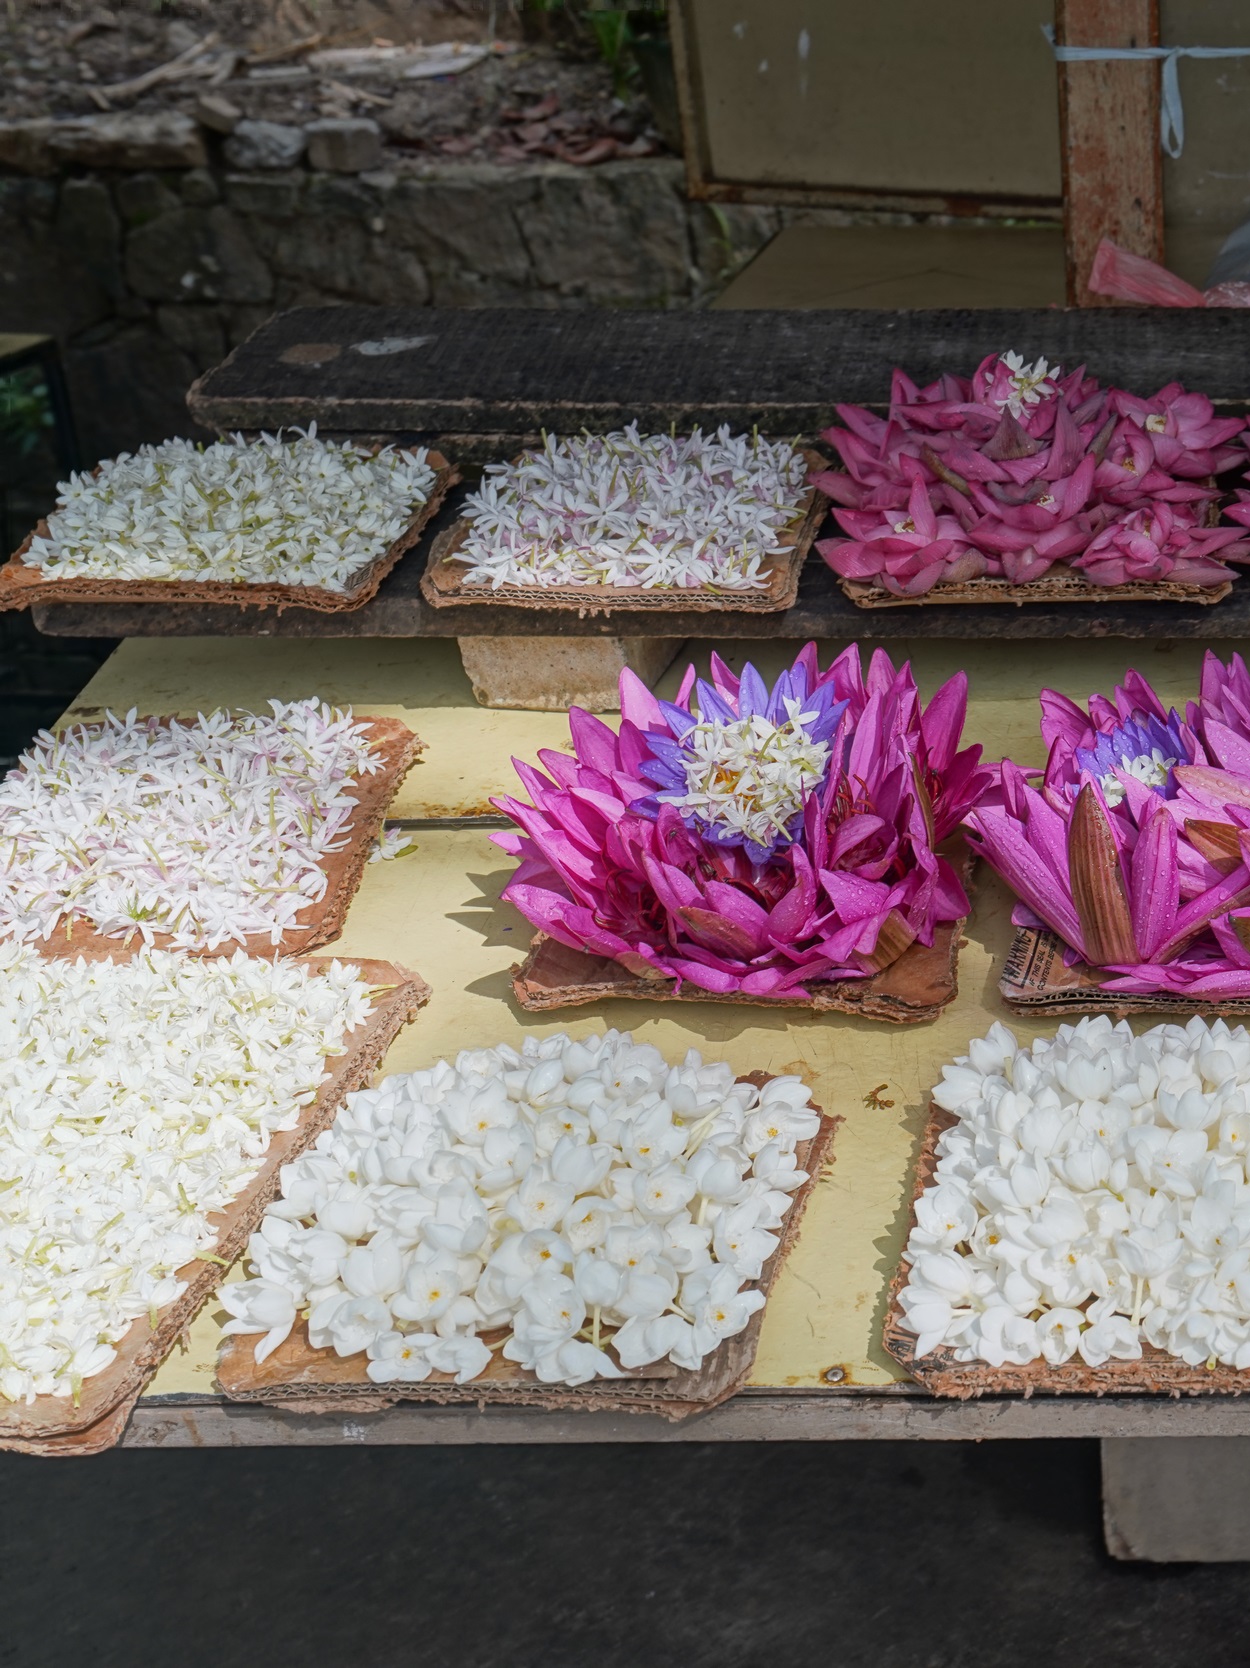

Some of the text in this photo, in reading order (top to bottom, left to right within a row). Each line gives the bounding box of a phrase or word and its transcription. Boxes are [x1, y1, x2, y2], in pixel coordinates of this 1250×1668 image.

[1036, 950, 1046, 963] SEAL
[1032, 964, 1042, 977] THIS
[1037, 960, 1053, 990] CONTENTS
[1029, 978, 1036, 986] IF
